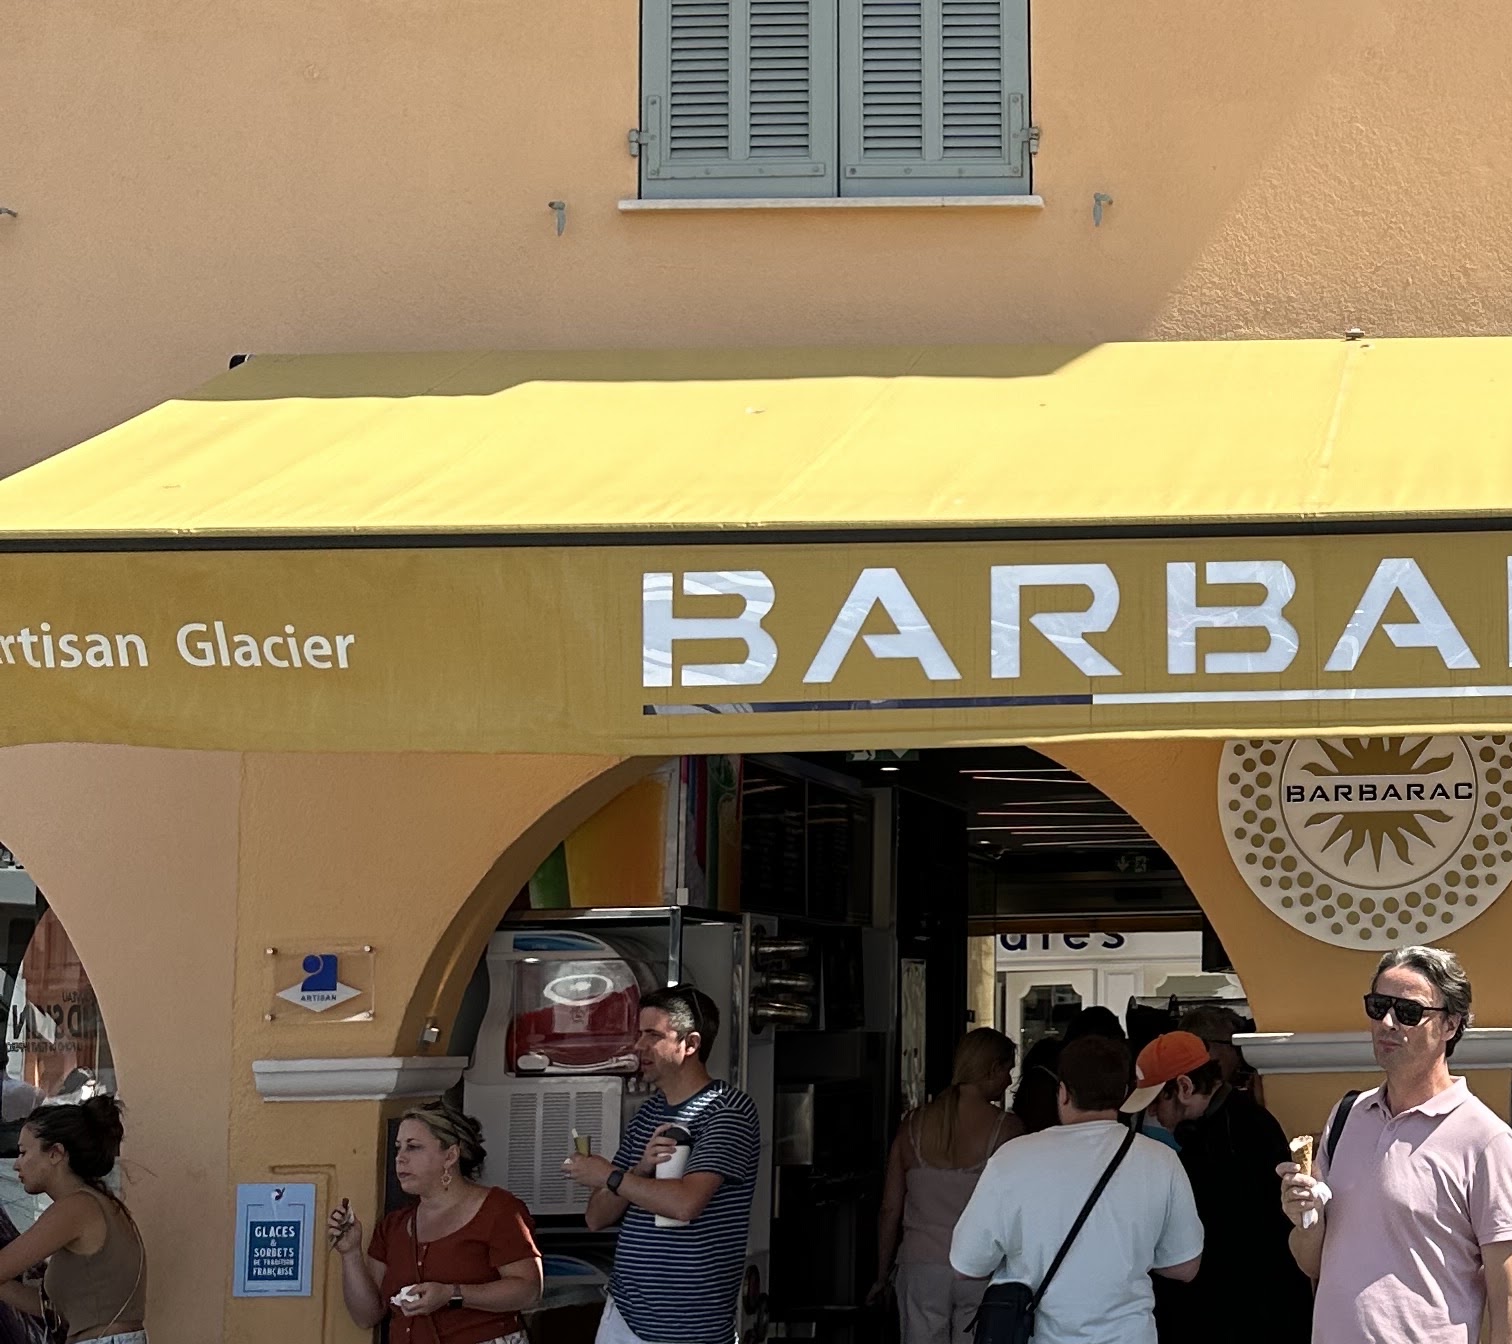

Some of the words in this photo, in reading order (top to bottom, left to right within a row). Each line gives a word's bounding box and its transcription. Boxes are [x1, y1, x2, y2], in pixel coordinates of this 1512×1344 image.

[0, 622, 149, 668] rtisan
[176, 620, 355, 669] Glacier
[1286, 783, 1473, 803] BARBARAC
[301, 994, 337, 1002] ARTISAN
[255, 1226, 295, 1237] GLACES
[270, 1239, 277, 1247] &
[254, 1248, 294, 1257] SORBETS
[253, 1267, 294, 1277] FRANÇAISE
